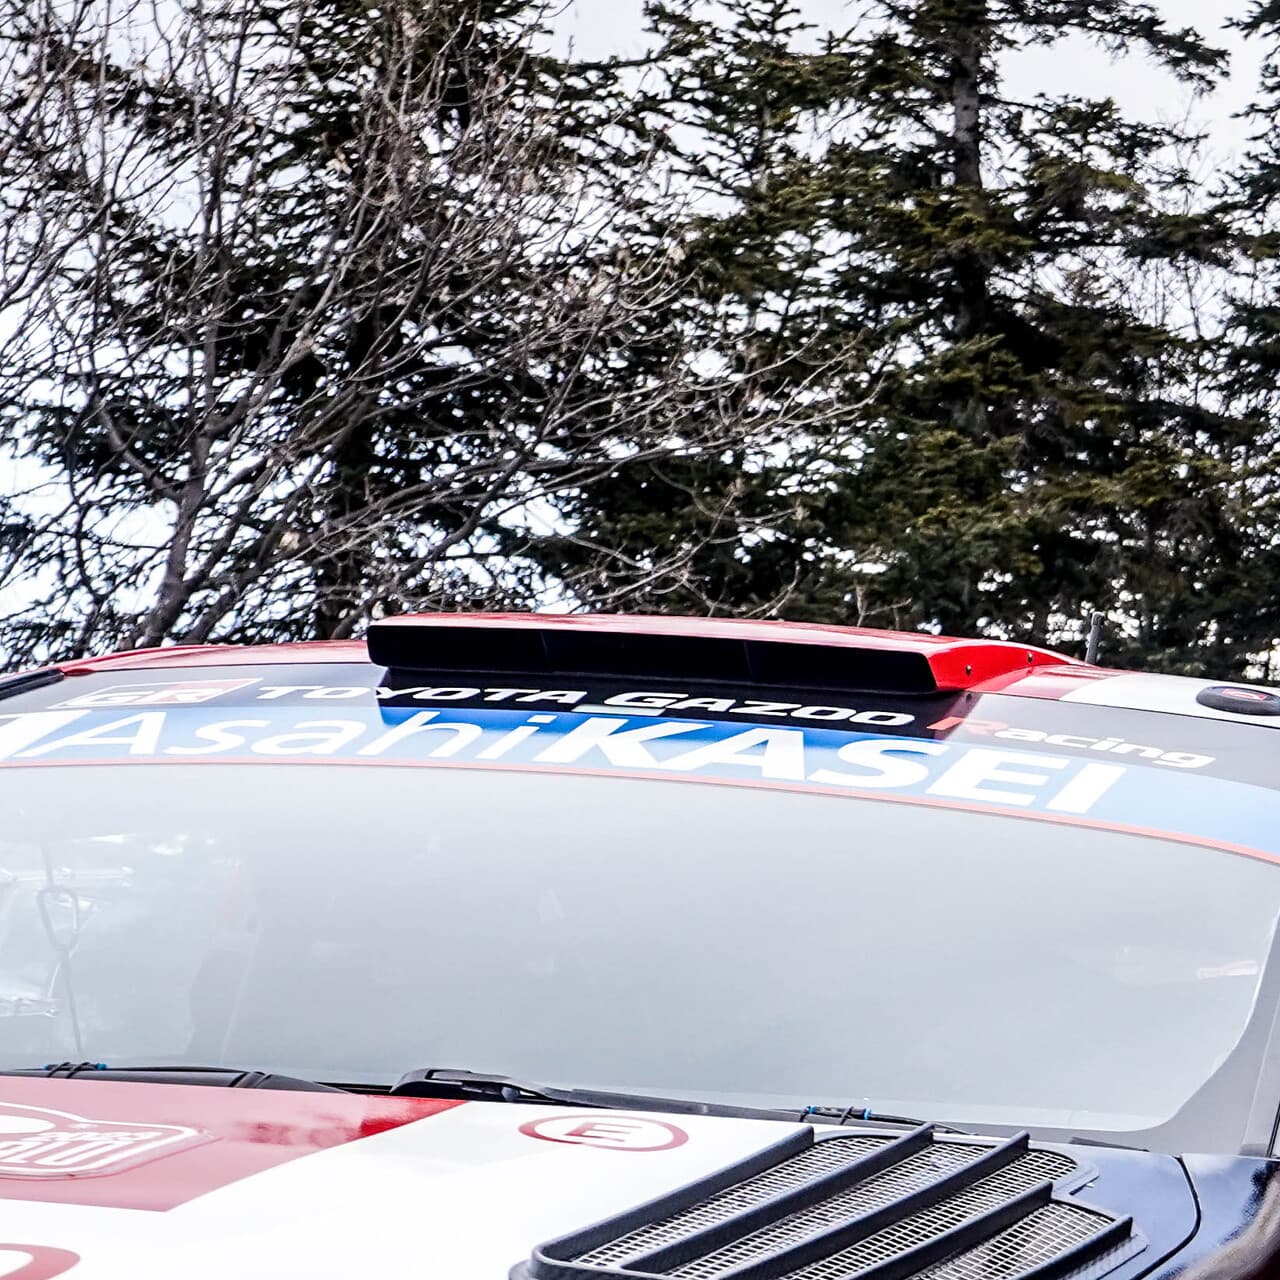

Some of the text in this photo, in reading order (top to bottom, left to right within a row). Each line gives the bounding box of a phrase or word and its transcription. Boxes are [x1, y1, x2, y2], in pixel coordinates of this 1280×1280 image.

[257, 684, 584, 705] TOYOTA
[603, 691, 915, 726] GAZOO
[926, 715, 1217, 768] Racing
